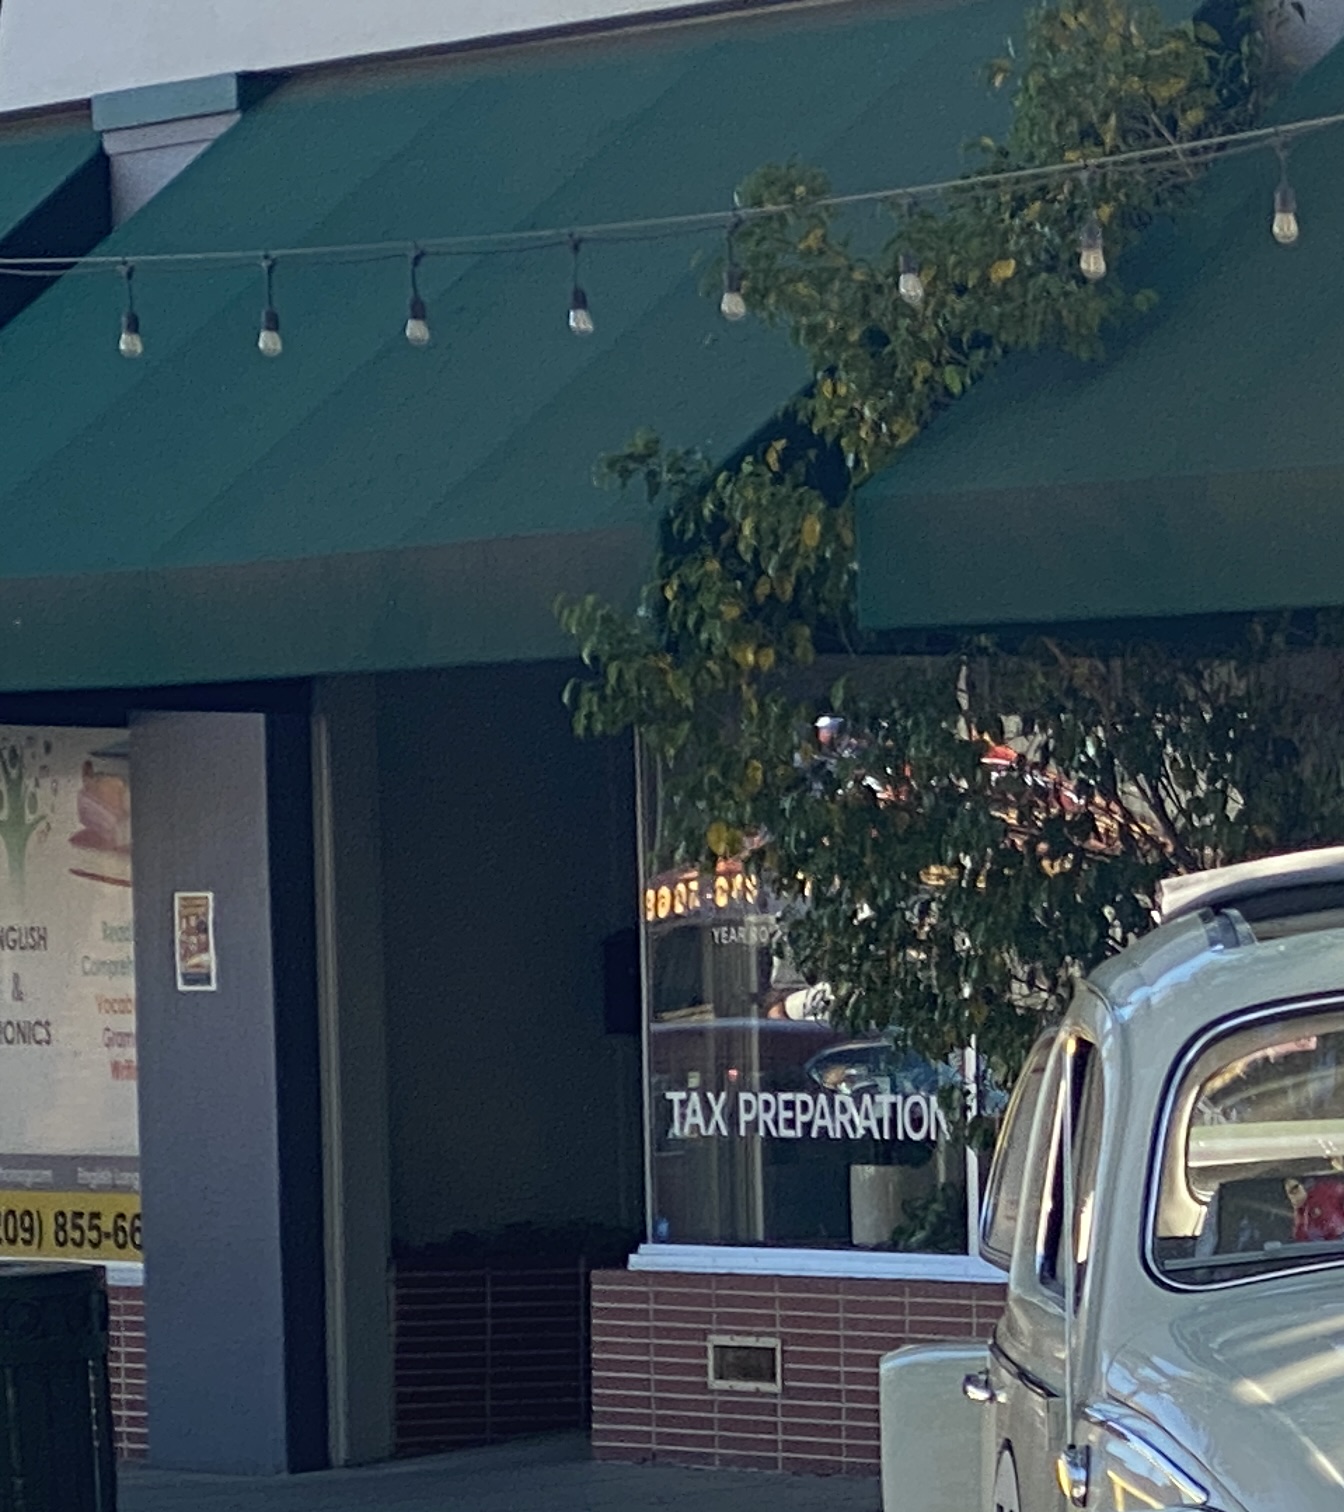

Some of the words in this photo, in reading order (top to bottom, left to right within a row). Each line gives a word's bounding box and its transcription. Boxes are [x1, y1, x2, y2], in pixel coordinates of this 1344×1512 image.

[0, 1019, 52, 1046] ONICS
[665, 1090, 729, 1137] TAX
[738, 1091, 950, 1141] PREPARATION
[0, 1209, 42, 1250] 09)
